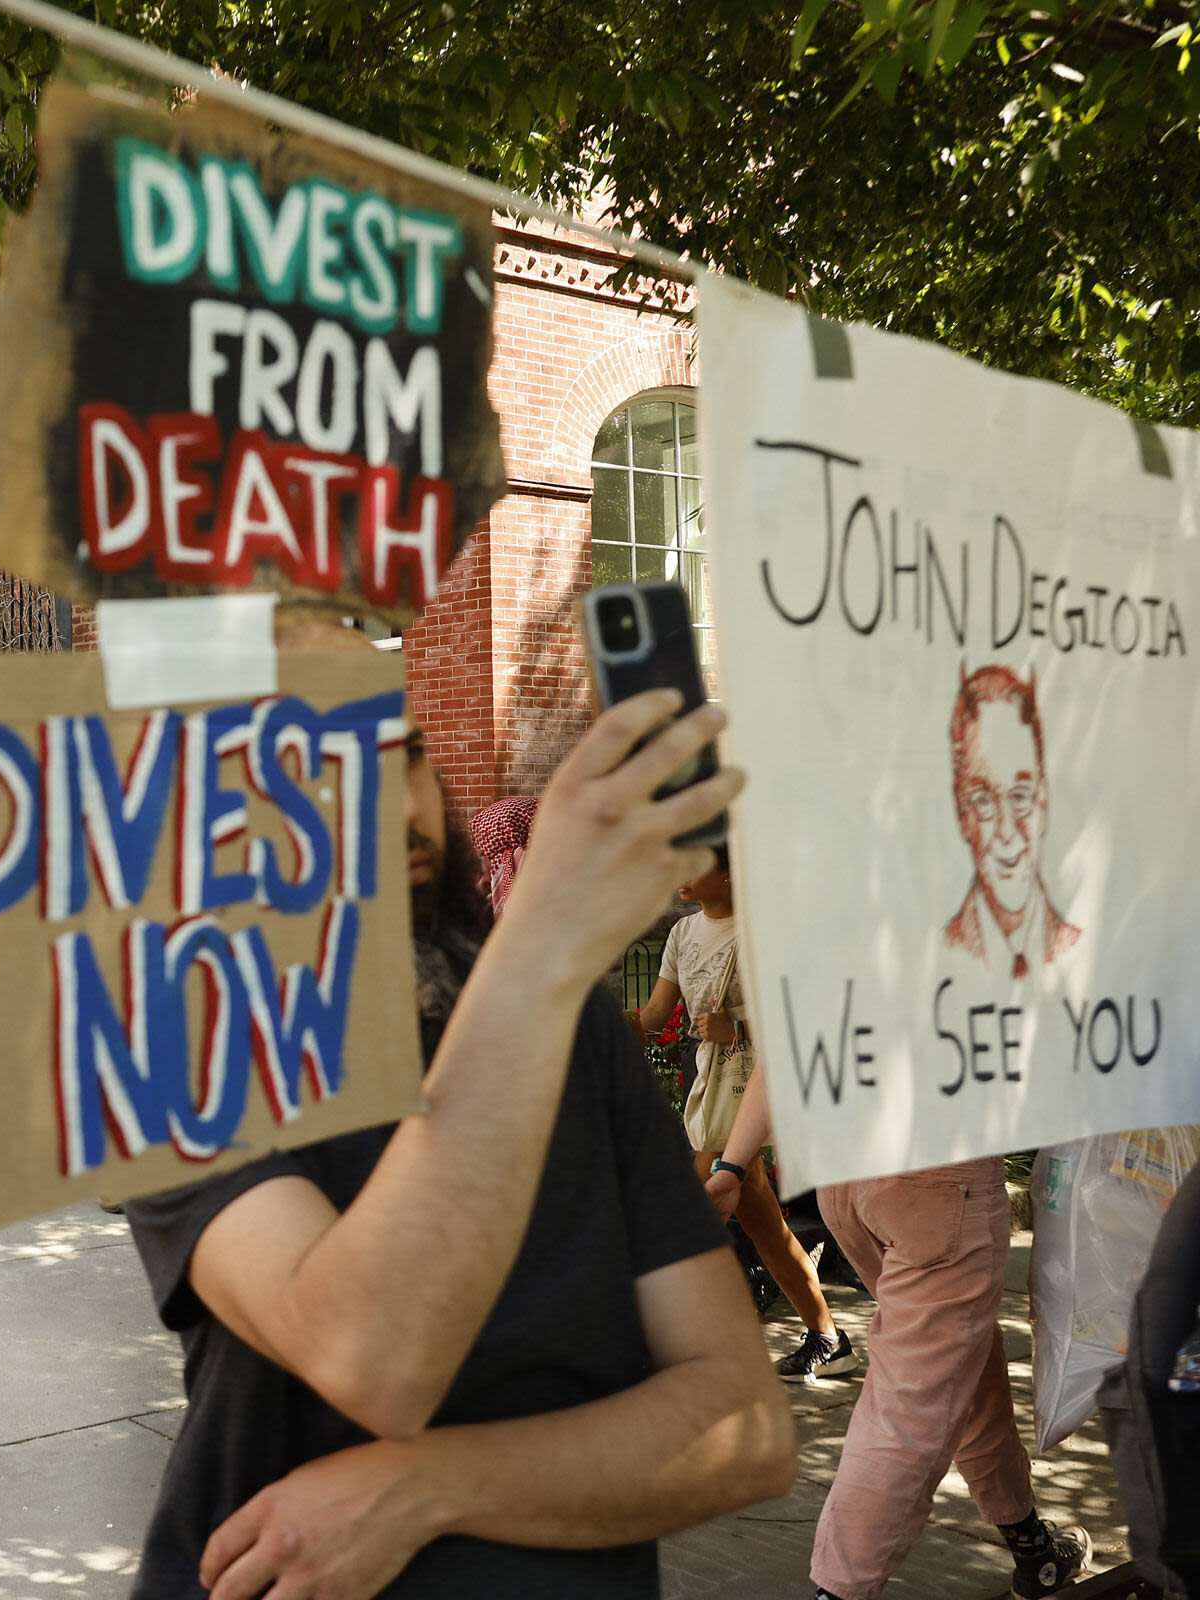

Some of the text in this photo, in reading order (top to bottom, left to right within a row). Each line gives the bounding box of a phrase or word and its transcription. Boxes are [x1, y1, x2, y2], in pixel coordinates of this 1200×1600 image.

[119, 141, 461, 331] DIVEST
[189, 299, 442, 478] FROM
[81, 405, 450, 606] DEATH
[755, 438, 970, 648] JOHN
[51, 896, 360, 1177] NOW
[933, 976, 1023, 1096] SEE
[1063, 995, 1163, 1074] YOU
